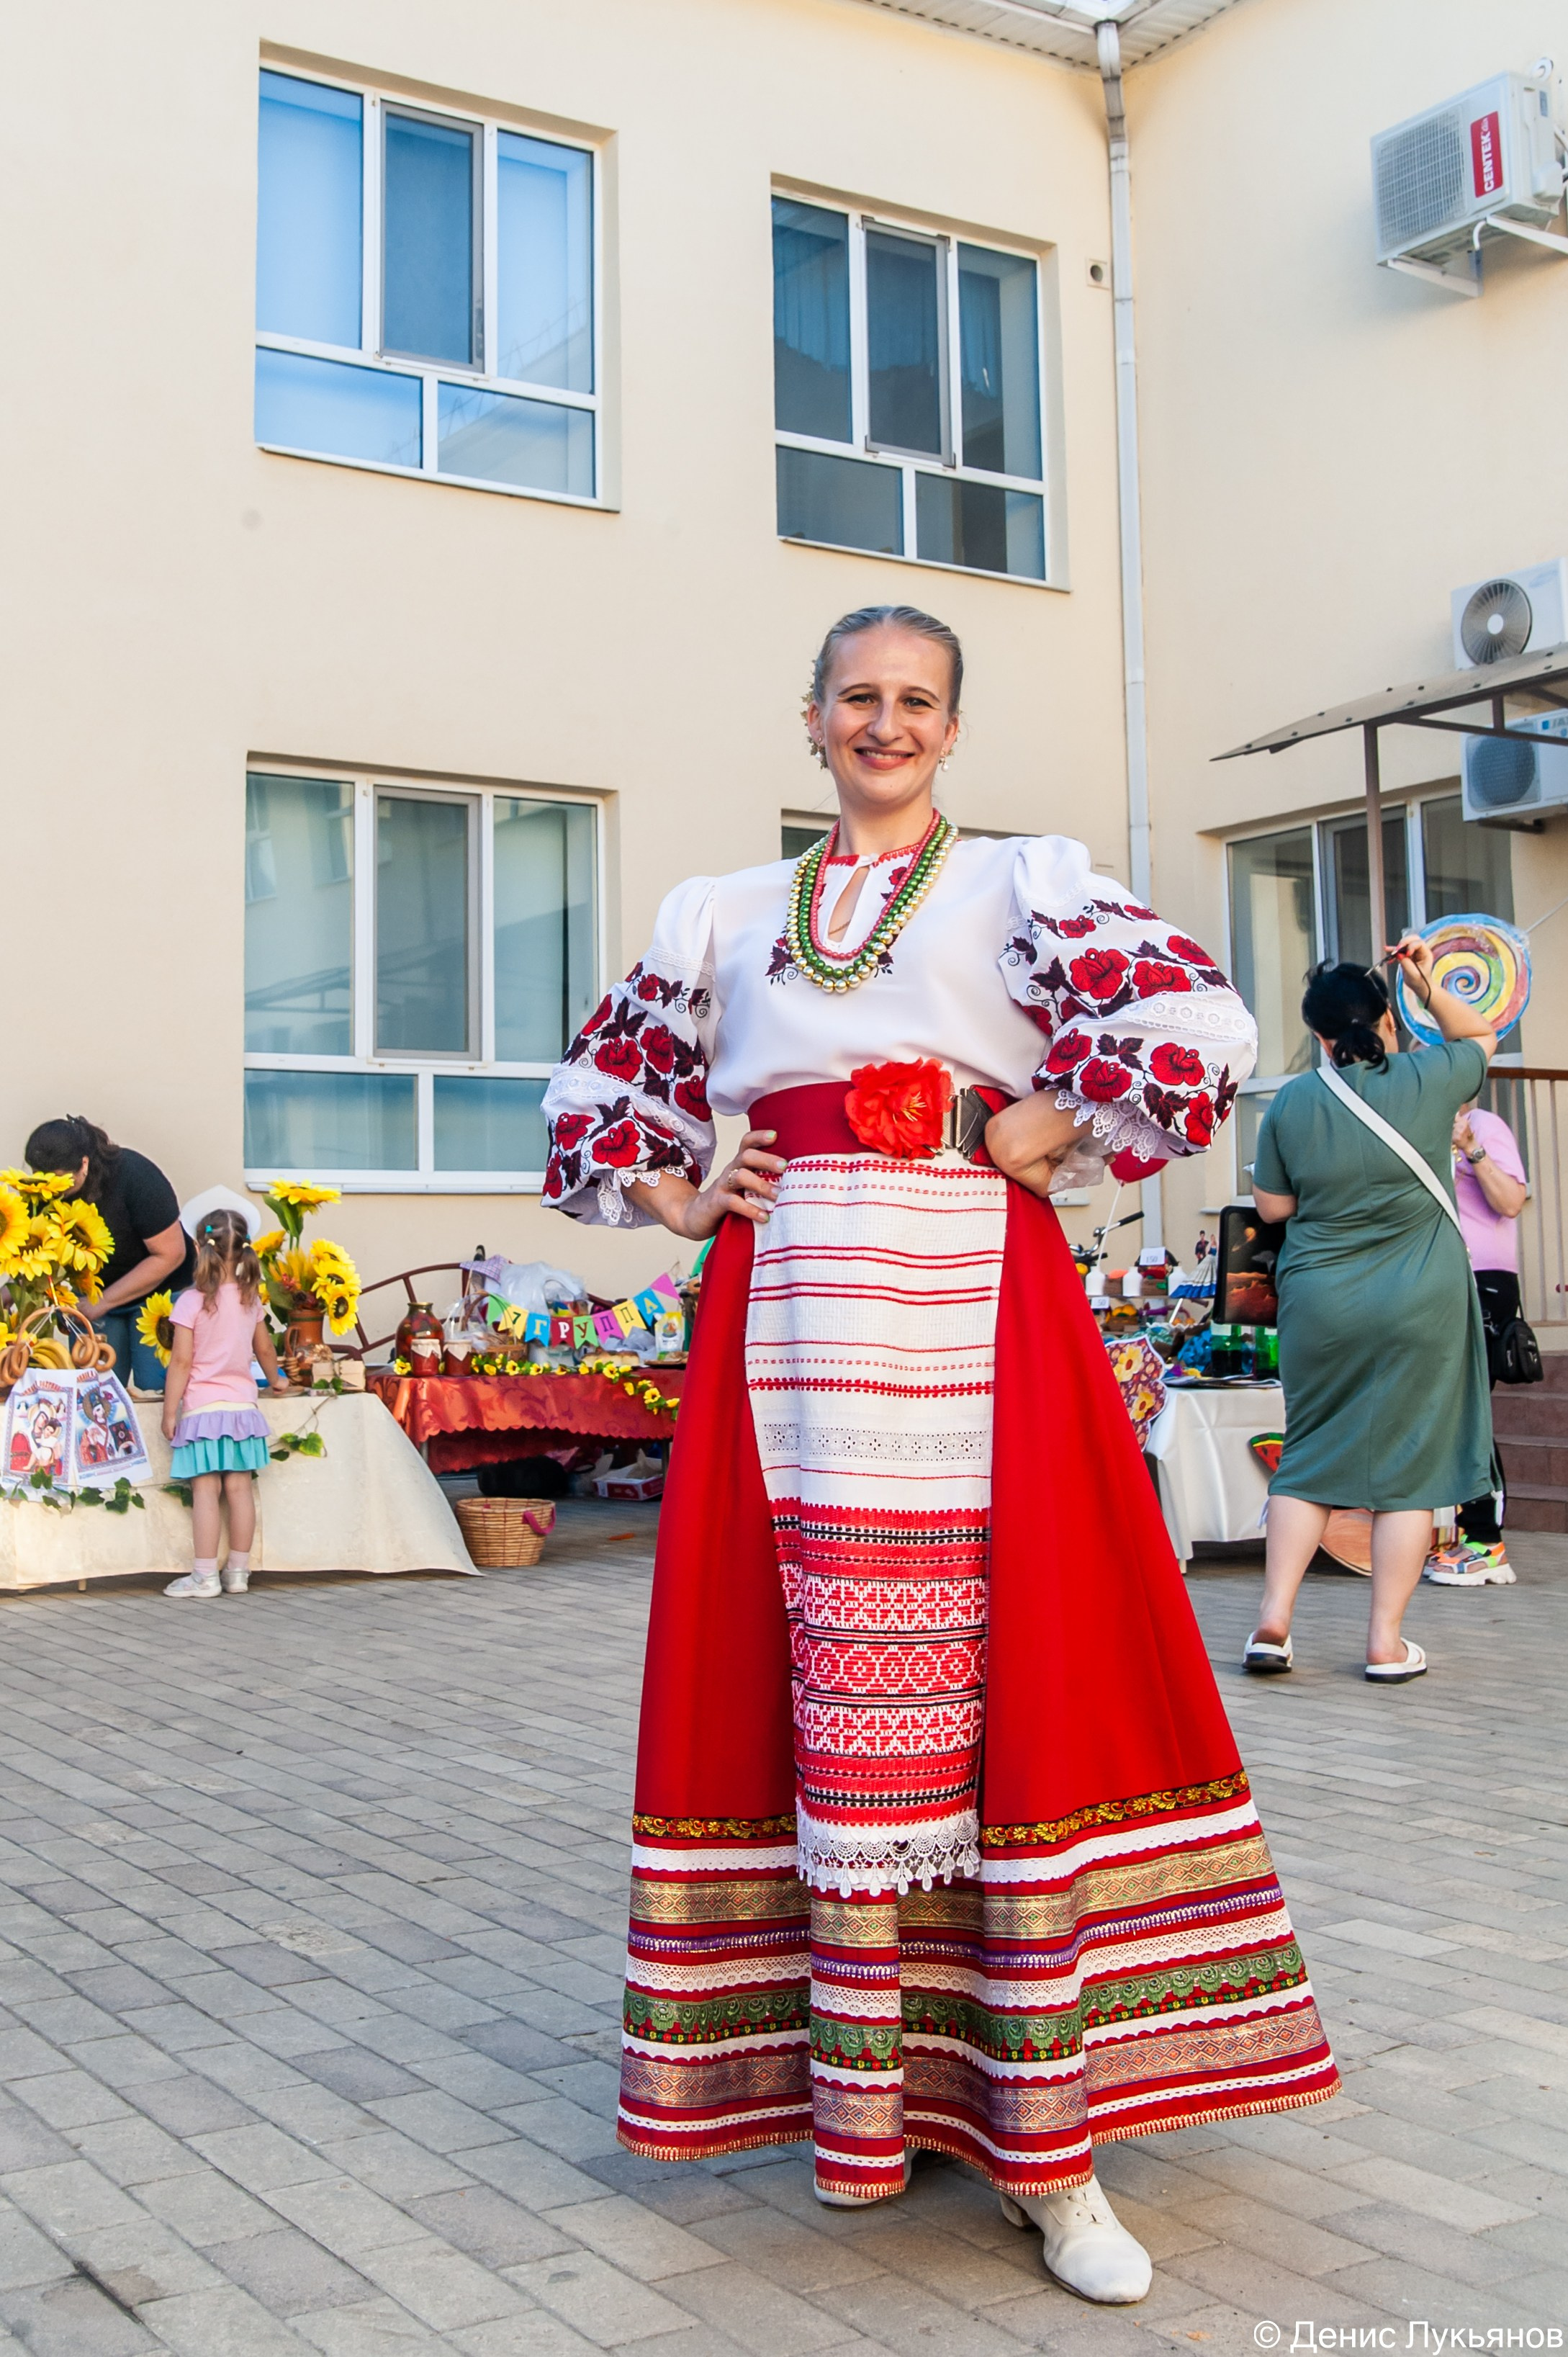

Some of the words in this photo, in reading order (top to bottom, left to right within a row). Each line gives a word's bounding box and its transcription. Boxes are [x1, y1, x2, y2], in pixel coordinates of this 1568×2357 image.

[1481, 131, 1495, 192] CENTEK
[513, 1311, 521, 1325] 7
[534, 1297, 659, 1339] ГРУППА
